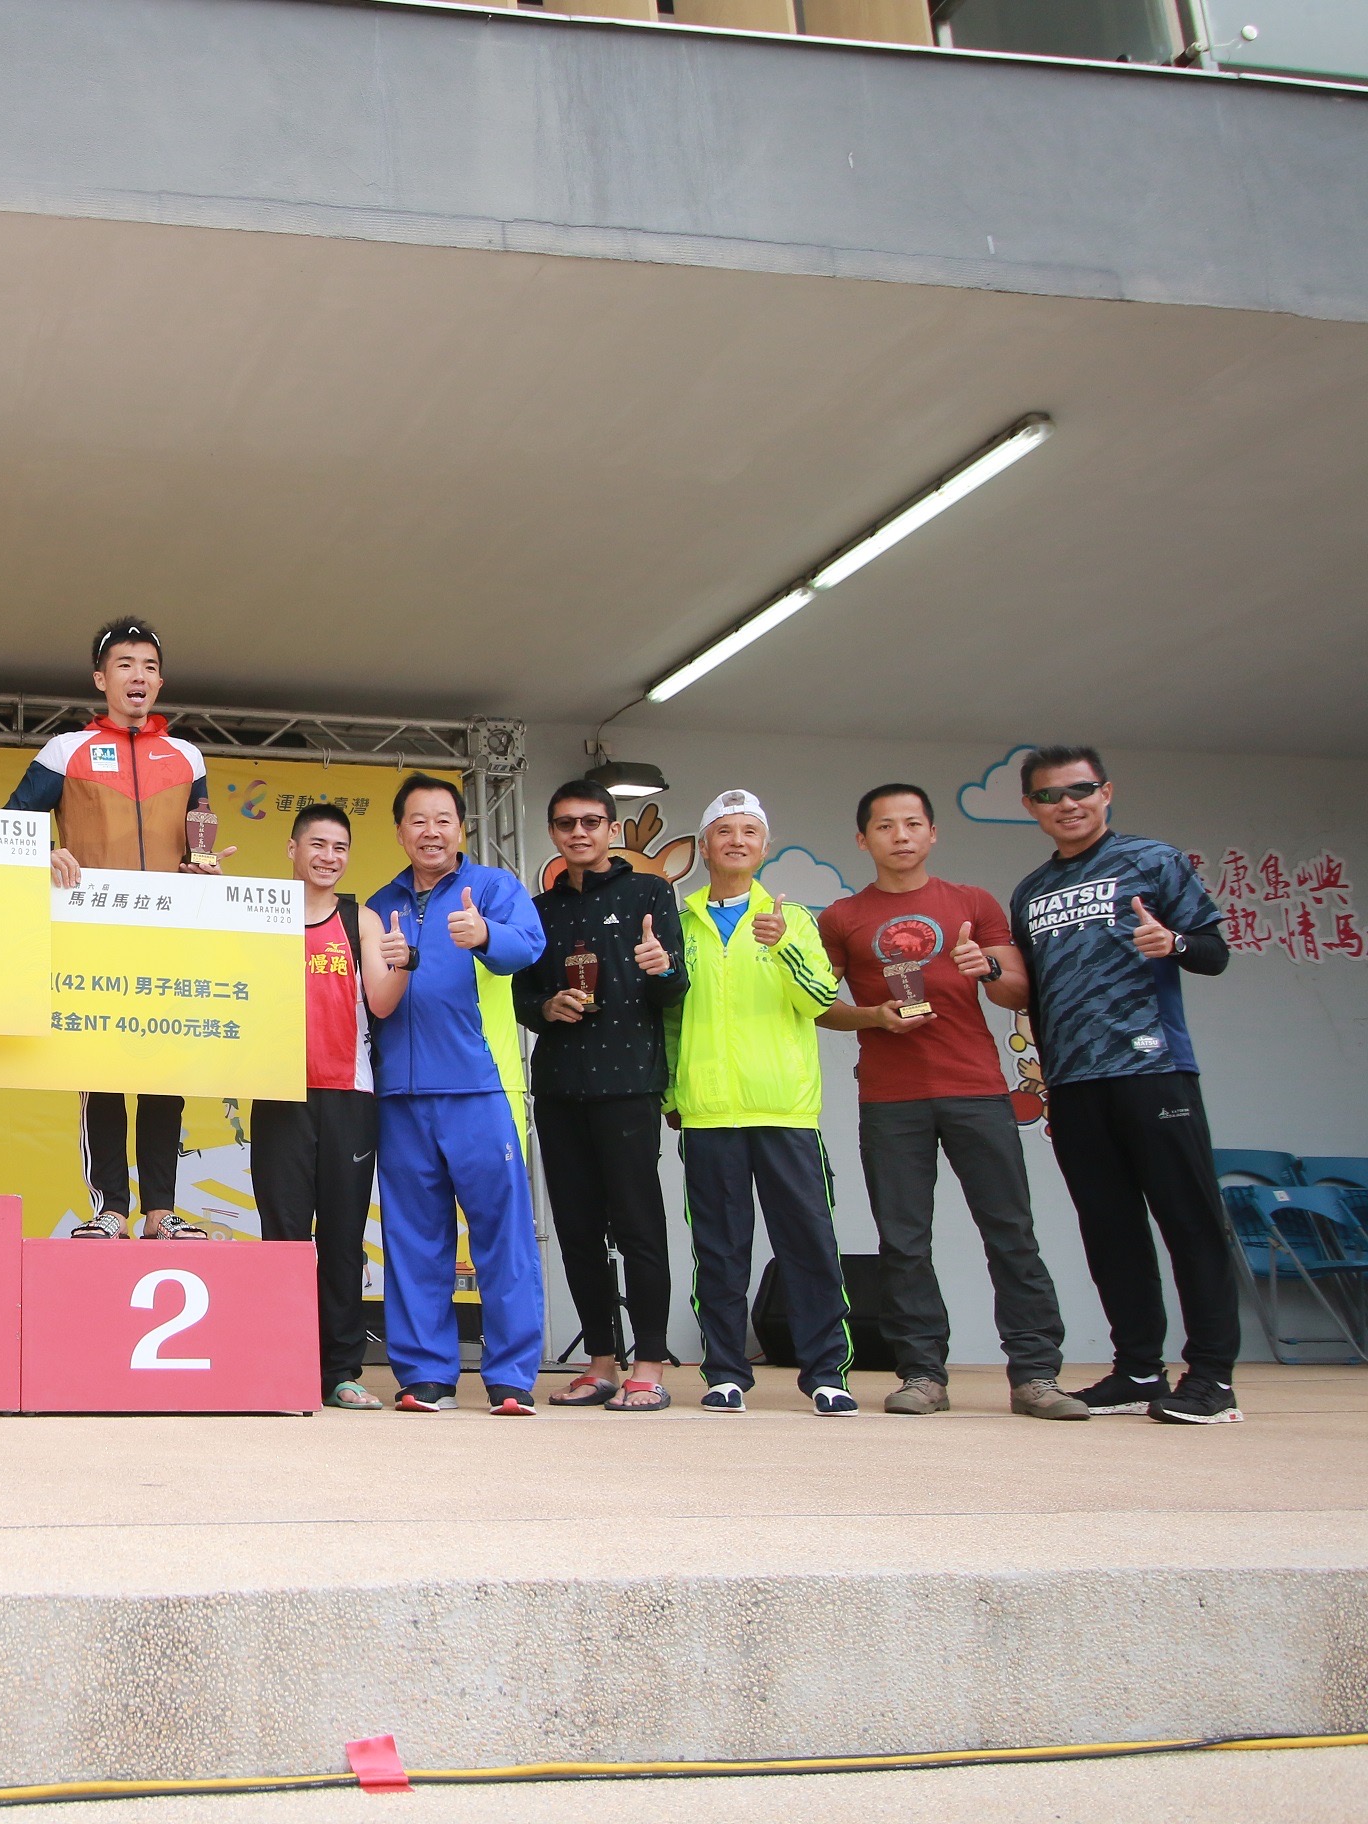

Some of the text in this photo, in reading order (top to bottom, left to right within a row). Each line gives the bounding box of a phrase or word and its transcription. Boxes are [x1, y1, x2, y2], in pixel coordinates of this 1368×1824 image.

[11, 848, 37, 856] 2020
[68, 891, 172, 911] 馬祖馬拉松
[226, 886, 291, 905] MATSU
[1028, 883, 1116, 920] MATSU
[247, 905, 291, 914] MARATHON
[267, 915, 292, 924] 2020
[1028, 902, 1114, 933] MARATHON
[1226, 902, 1368, 960] 熱情馬
[308, 954, 348, 976] 慢跑
[51, 972, 86, 993] (42
[134, 976, 250, 1001] 男子組第二名
[115, 1016, 241, 1040] 40,000元獎金
[129, 1268, 211, 1370] 2
